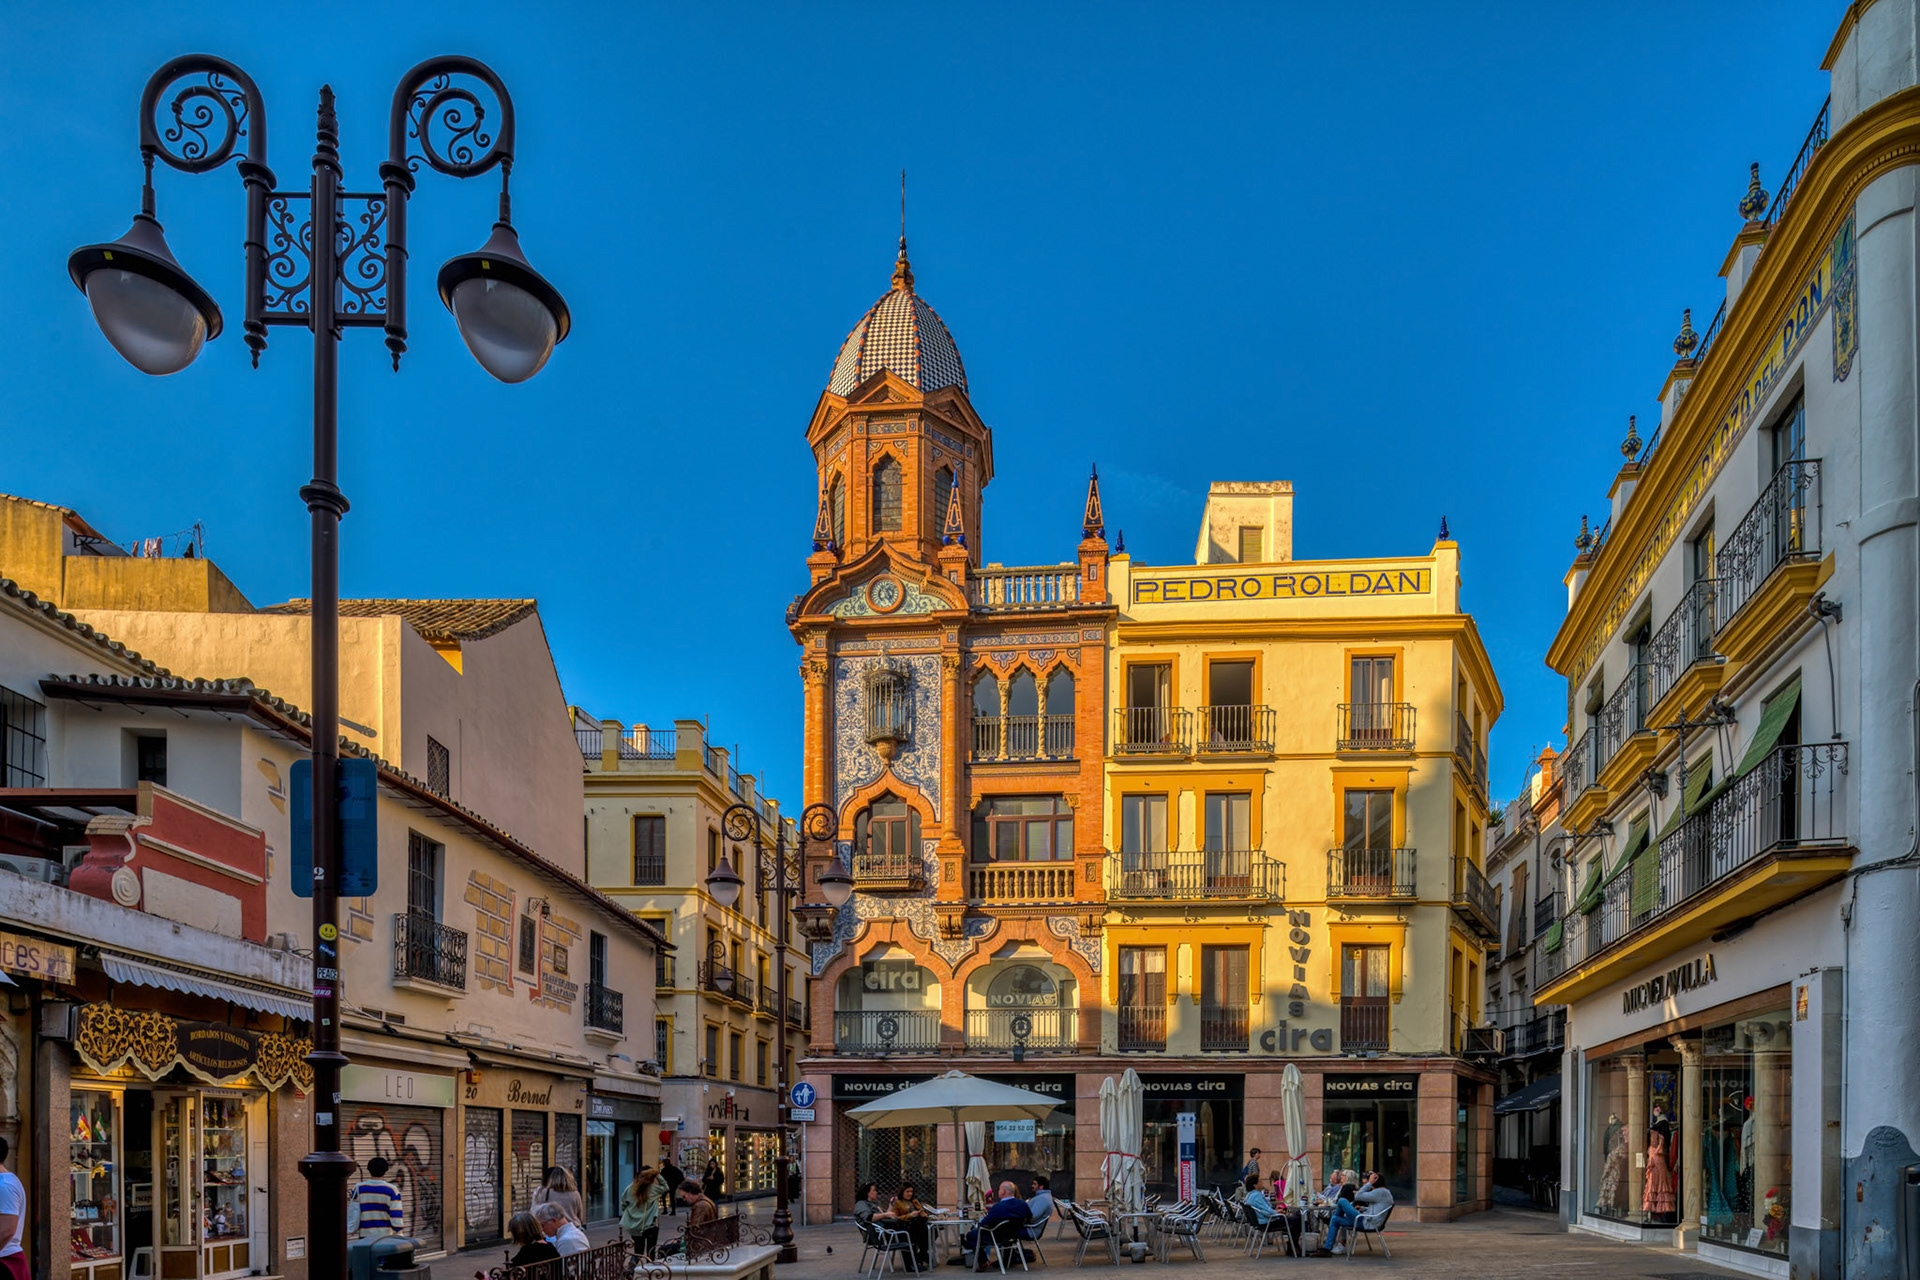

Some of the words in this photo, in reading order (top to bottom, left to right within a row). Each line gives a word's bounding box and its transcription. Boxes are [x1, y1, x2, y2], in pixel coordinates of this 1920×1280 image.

[1702, 389, 1751, 486] PLAZA
[1754, 357, 1778, 404] DEL
[1783, 268, 1822, 359] PAN
[1136, 577, 1261, 602] PEDRO
[1273, 571, 1421, 597] ROLDAN
[313, 867, 324, 880] 2
[0, 941, 40, 971] ces
[1288, 910, 1309, 1017] NOVIAS
[865, 964, 919, 990] cira
[990, 994, 1057, 1006] NOVIAS
[190, 1029, 220, 1040] BORDADOS
[224, 1032, 250, 1050] ESMALTES
[1260, 1019, 1332, 1051] cira
[218, 1058, 248, 1068] RELIGIOSOS
[385, 1074, 413, 1099] LEO
[465, 1086, 478, 1099] 20
[507, 1079, 552, 1105] Bernal
[844, 1083, 894, 1091] NOVIAS
[1034, 1081, 1062, 1092] cira
[1142, 1083, 1192, 1091] NOVIAS
[1197, 1080, 1225, 1091] cira
[1326, 1082, 1379, 1090] NOVIAS
[1383, 1080, 1413, 1091] cira
[574, 1099, 583, 1109] 20
